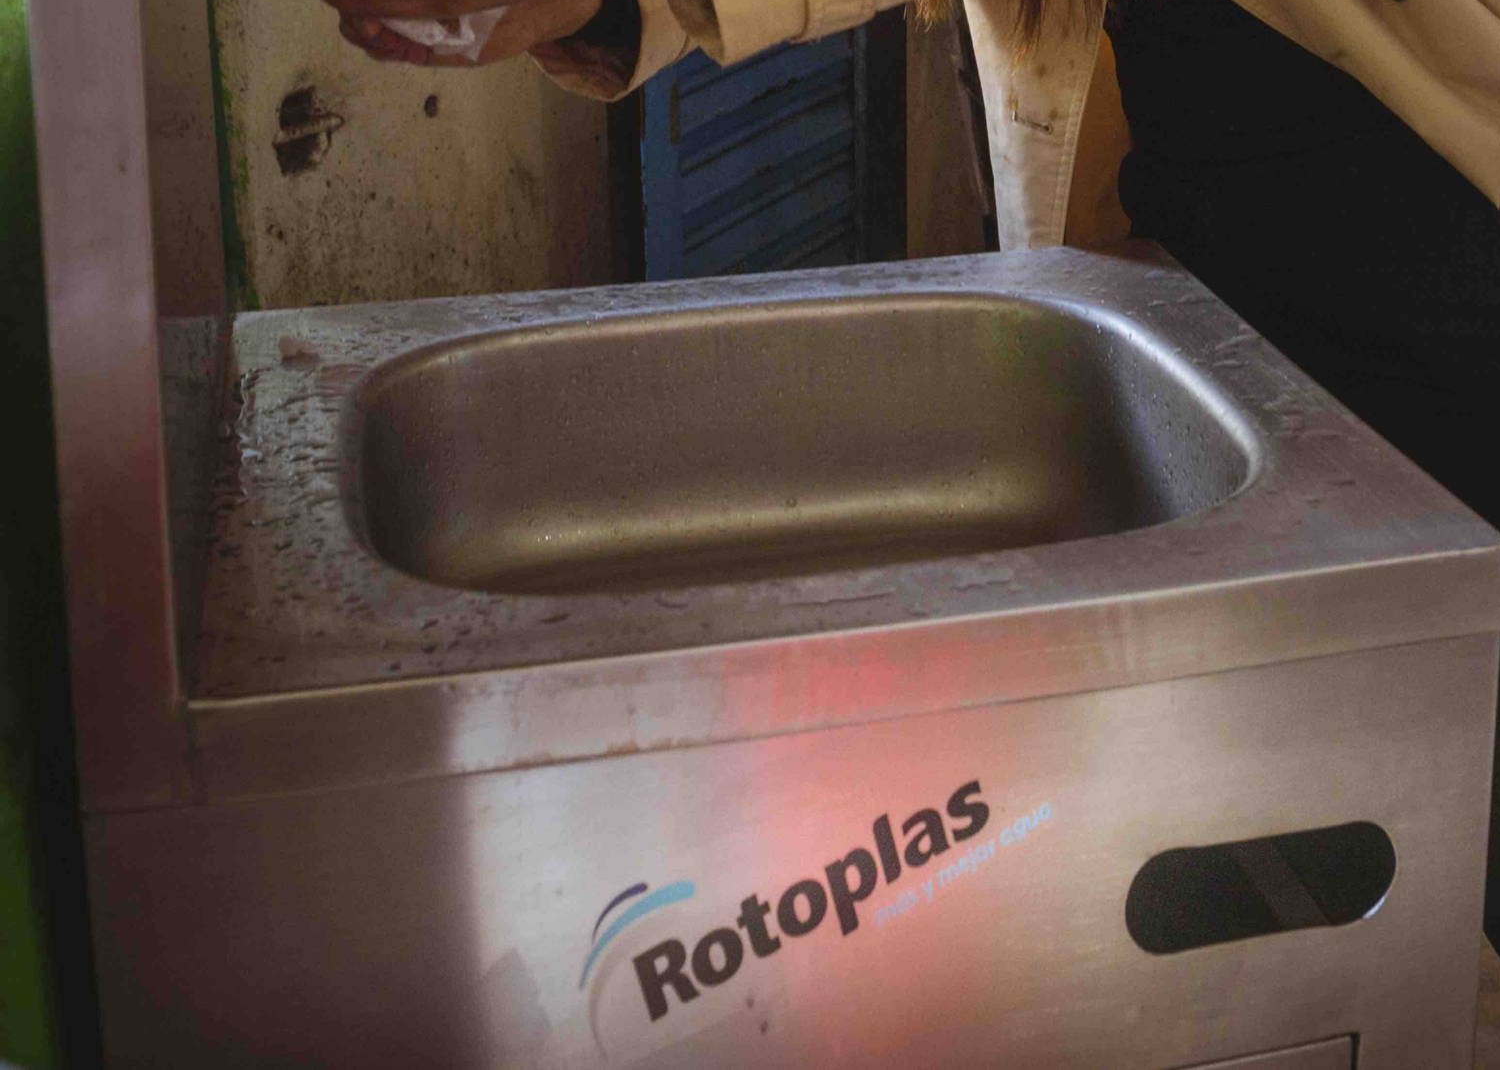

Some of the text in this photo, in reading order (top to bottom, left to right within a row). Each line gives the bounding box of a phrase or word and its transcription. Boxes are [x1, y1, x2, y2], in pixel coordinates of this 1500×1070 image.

[631, 779, 991, 1023] Rotoplas
[921, 876, 936, 905] y
[936, 838, 996, 889] mejor
[999, 800, 1054, 848] agua
